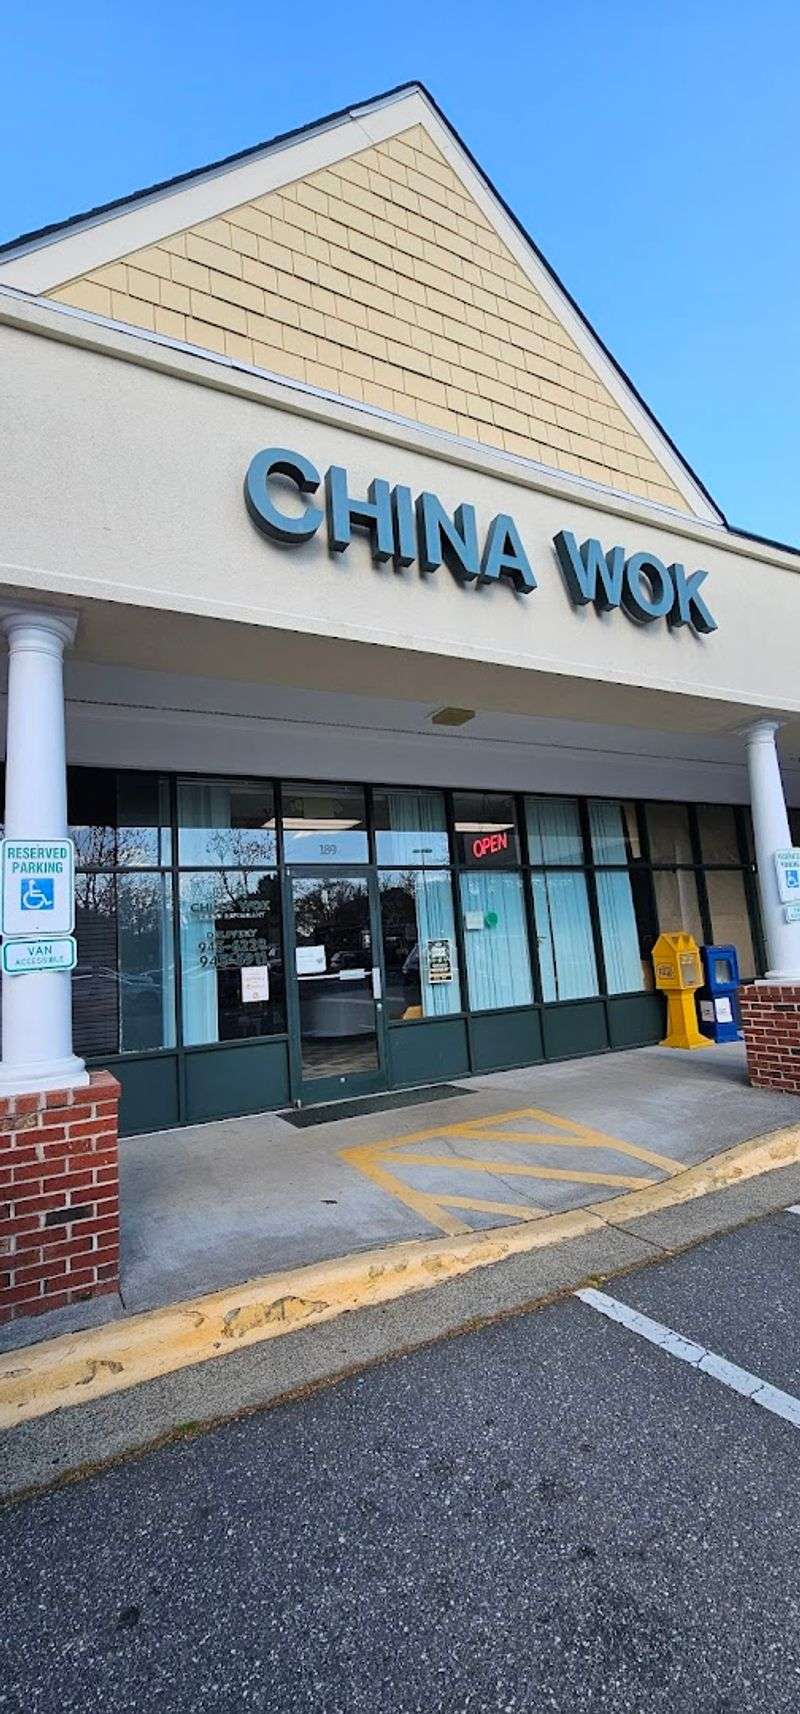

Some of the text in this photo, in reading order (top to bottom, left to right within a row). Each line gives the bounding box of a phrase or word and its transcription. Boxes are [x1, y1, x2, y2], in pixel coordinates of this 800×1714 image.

[243, 446, 718, 634] CHINA WOK
[319, 844, 337, 855] 189
[472, 832, 508, 858] OPEN
[7, 847, 68, 859] RESERVED
[12, 861, 64, 873] PARKING
[190, 902, 235, 914] CHI
[27, 945, 53, 957] VAN
